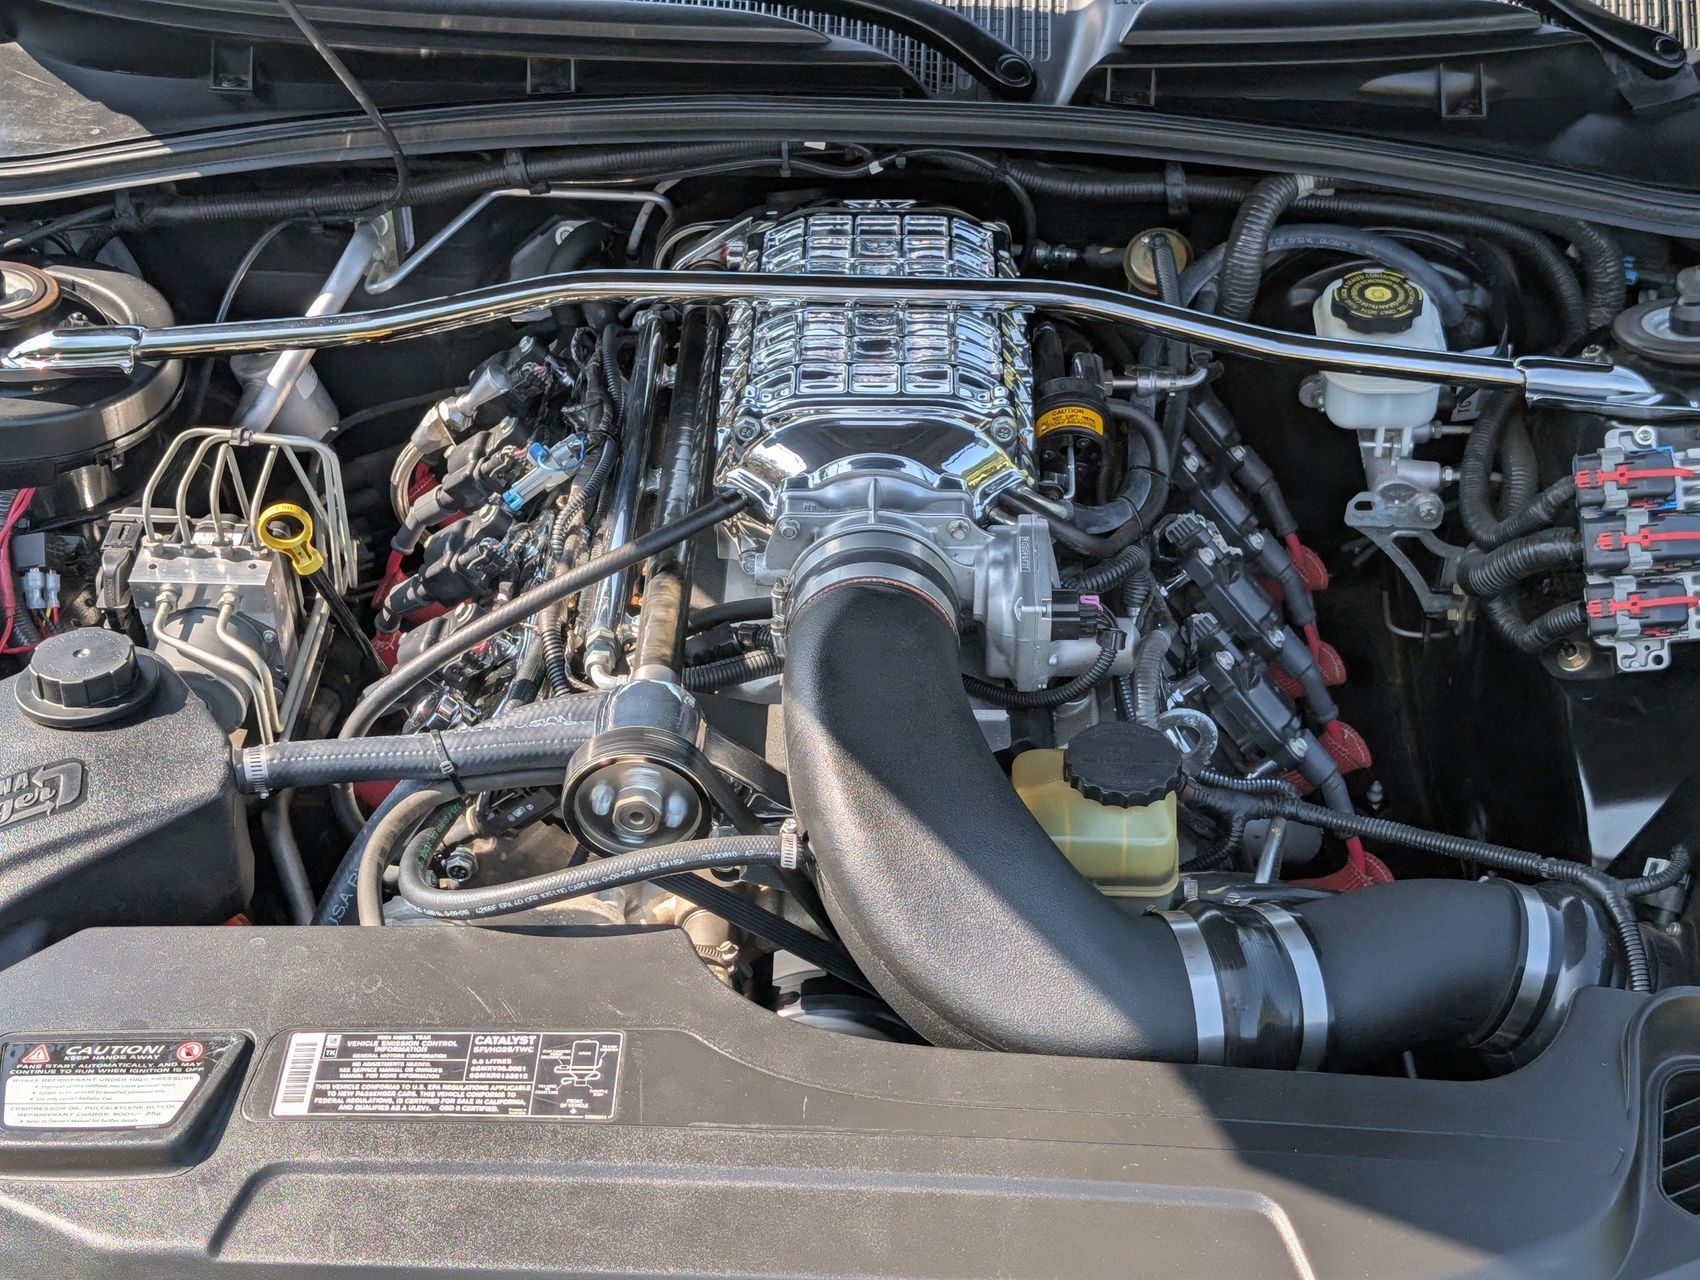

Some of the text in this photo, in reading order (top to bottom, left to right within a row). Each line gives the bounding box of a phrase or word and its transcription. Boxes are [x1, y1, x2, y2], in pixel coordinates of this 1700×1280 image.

[639, 863, 658, 873] MADE
[474, 1036, 536, 1045] CATALYST
[66, 1044, 165, 1055] CAUTION!
